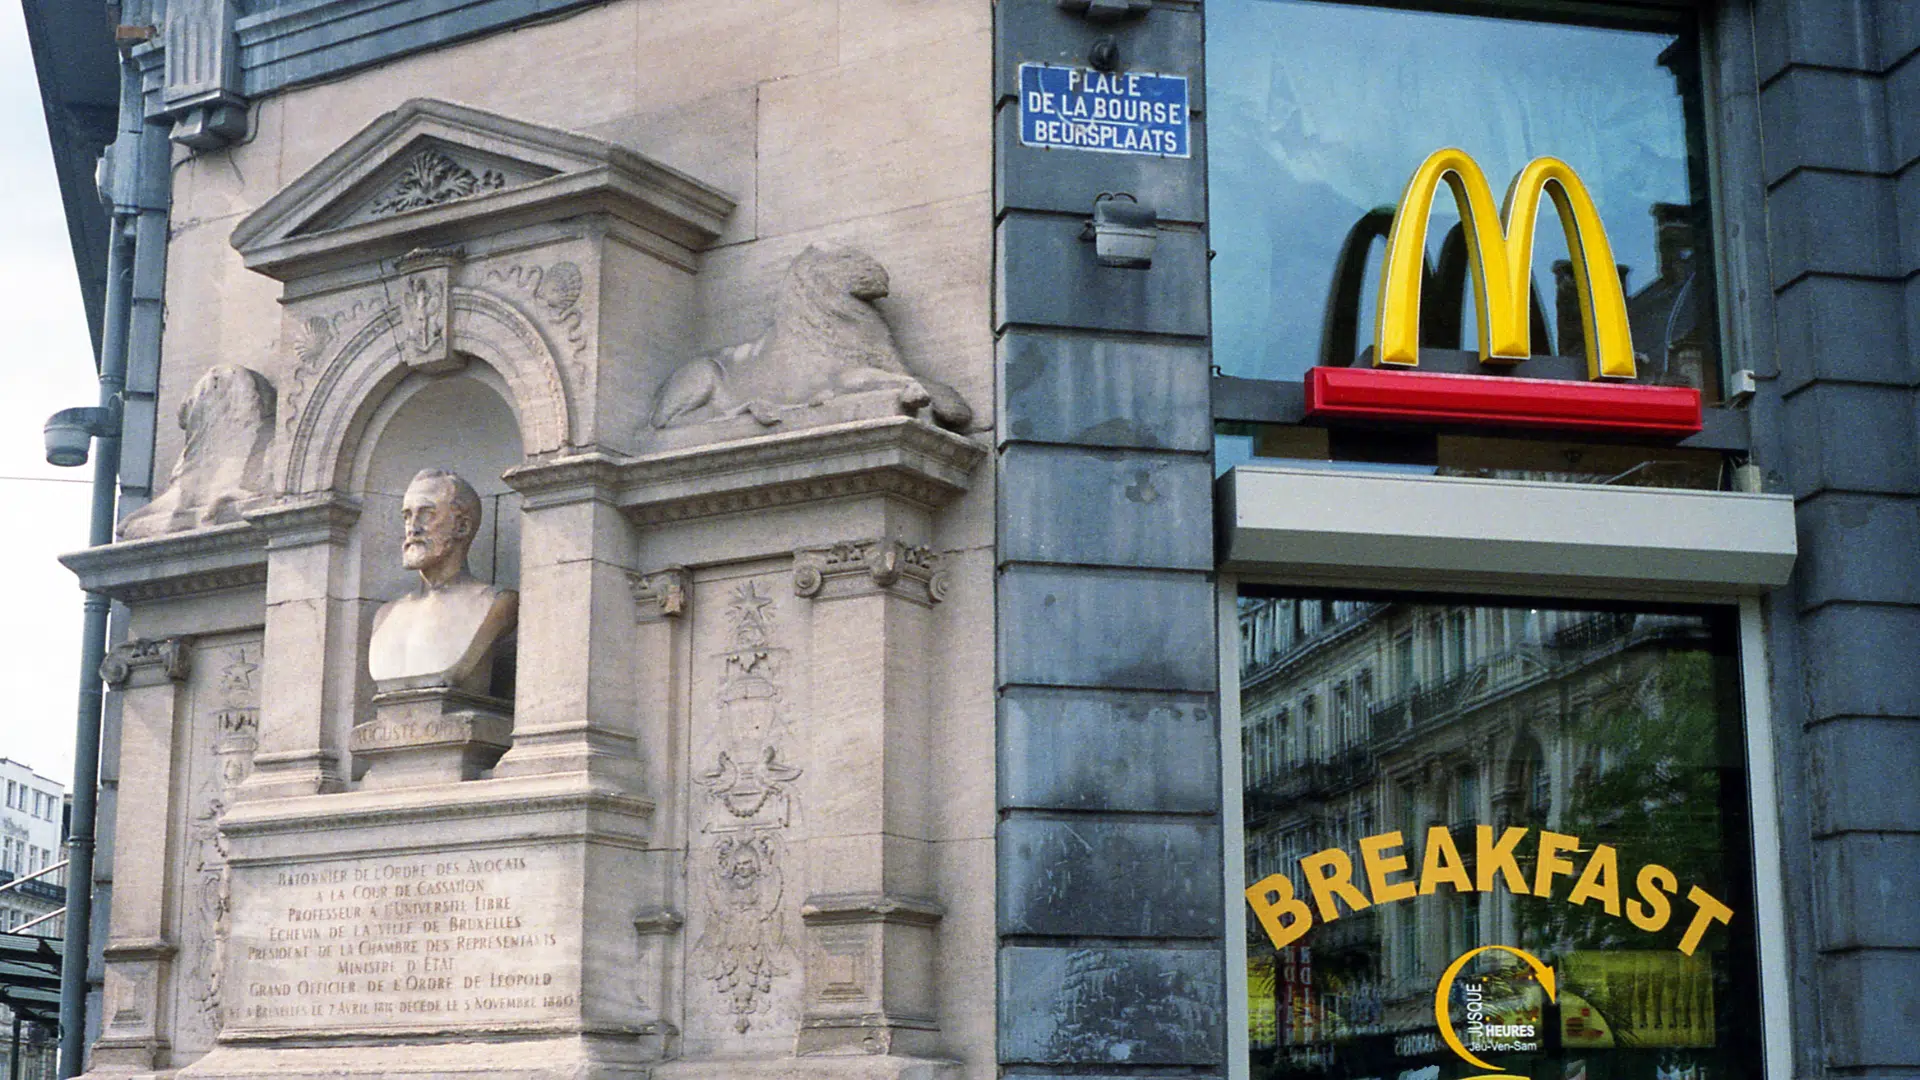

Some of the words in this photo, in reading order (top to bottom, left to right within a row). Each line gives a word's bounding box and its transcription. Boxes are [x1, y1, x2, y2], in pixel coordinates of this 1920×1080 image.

[1069, 70, 1141, 97] PLACE
[1028, 91, 1055, 114] DE
[1062, 96, 1087, 117] LA
[1094, 97, 1182, 125] BOURSE
[1035, 120, 1177, 153] BEURSPLAATS
[355, 869, 371, 881] DE
[437, 862, 459, 875] DES
[467, 857, 526, 873] AVOCATS
[331, 889, 344, 900] LA
[353, 885, 387, 899] COUR
[395, 884, 410, 897] DE
[417, 879, 484, 895] CASSATION
[1244, 824, 1735, 957] BREAKFAST
[288, 906, 361, 922] PROFESSEUR
[475, 896, 511, 911] LIBRE
[270, 927, 320, 942] ECHEVIN
[329, 926, 344, 938] DE
[354, 924, 370, 937] LA
[378, 921, 413, 935] VILLE
[423, 920, 440, 933] DE
[450, 916, 521, 931] BRUXELLES
[318, 945, 332, 957] DE
[340, 944, 353, 956] LA
[359, 940, 418, 955] CHAMBRE
[426, 939, 450, 952] DES
[337, 960, 394, 975] MINISTRE
[250, 982, 291, 997] GRAND
[297, 980, 356, 995] OFFICIER
[367, 980, 384, 992] DE
[464, 975, 480, 989] DE
[490, 972, 552, 988] LEOPOLD
[312, 1004, 323, 1015] LE
[338, 1001, 369, 1015] AVRIL
[400, 1000, 441, 1013] DECEDE
[447, 1000, 458, 1012] LE
[475, 997, 537, 1010] NOVEMBRE
[1466, 984, 1484, 1037] JUSQUE
[1485, 1025, 1535, 1037] HEURES
[1469, 1041, 1537, 1052] Jeu-Ven-Sam
